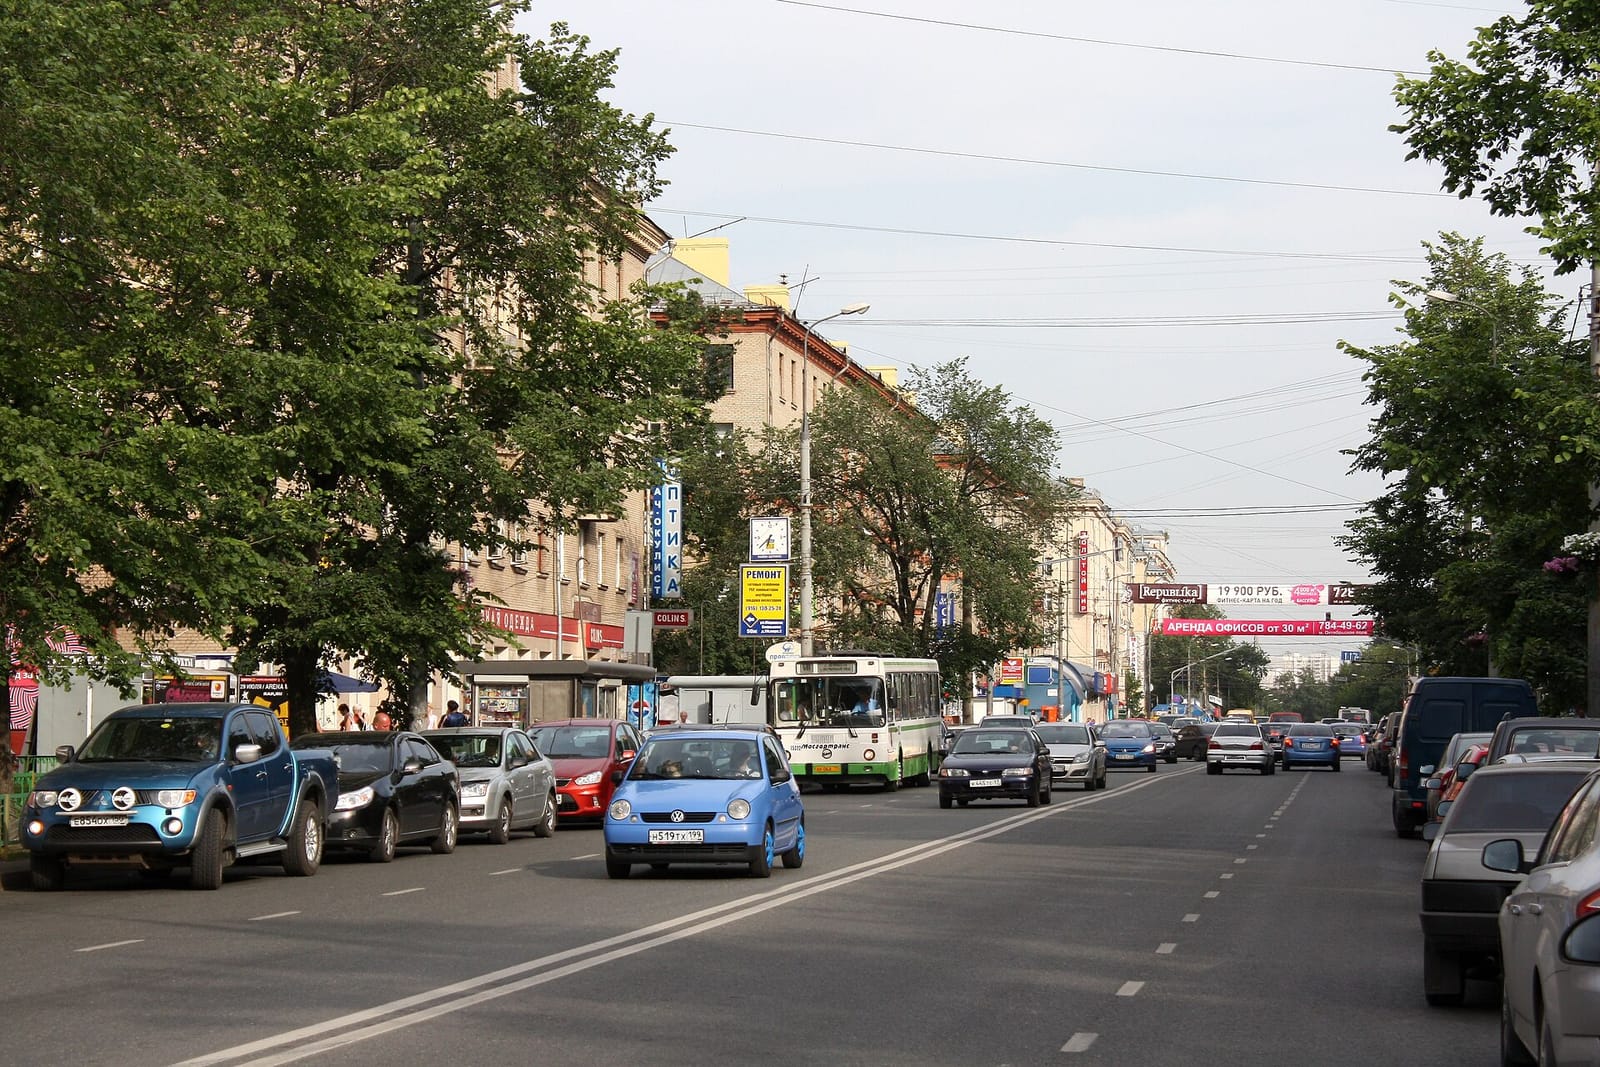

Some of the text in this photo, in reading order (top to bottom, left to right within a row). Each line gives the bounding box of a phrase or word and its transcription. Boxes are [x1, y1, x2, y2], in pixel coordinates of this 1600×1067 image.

[746, 570, 782, 580] РЕМОНТ
[1218, 586, 1283, 596] 19 900 РУБ.
[504, 613, 535, 633] ОДЕЖДА
[1167, 622, 1213, 633] АРЕНДА
[1215, 623, 1264, 633] ОФИСОВ
[1267, 625, 1279, 633] от
[1282, 623, 1294, 633] 30
[1319, 621, 1368, 630] 784-49-62
